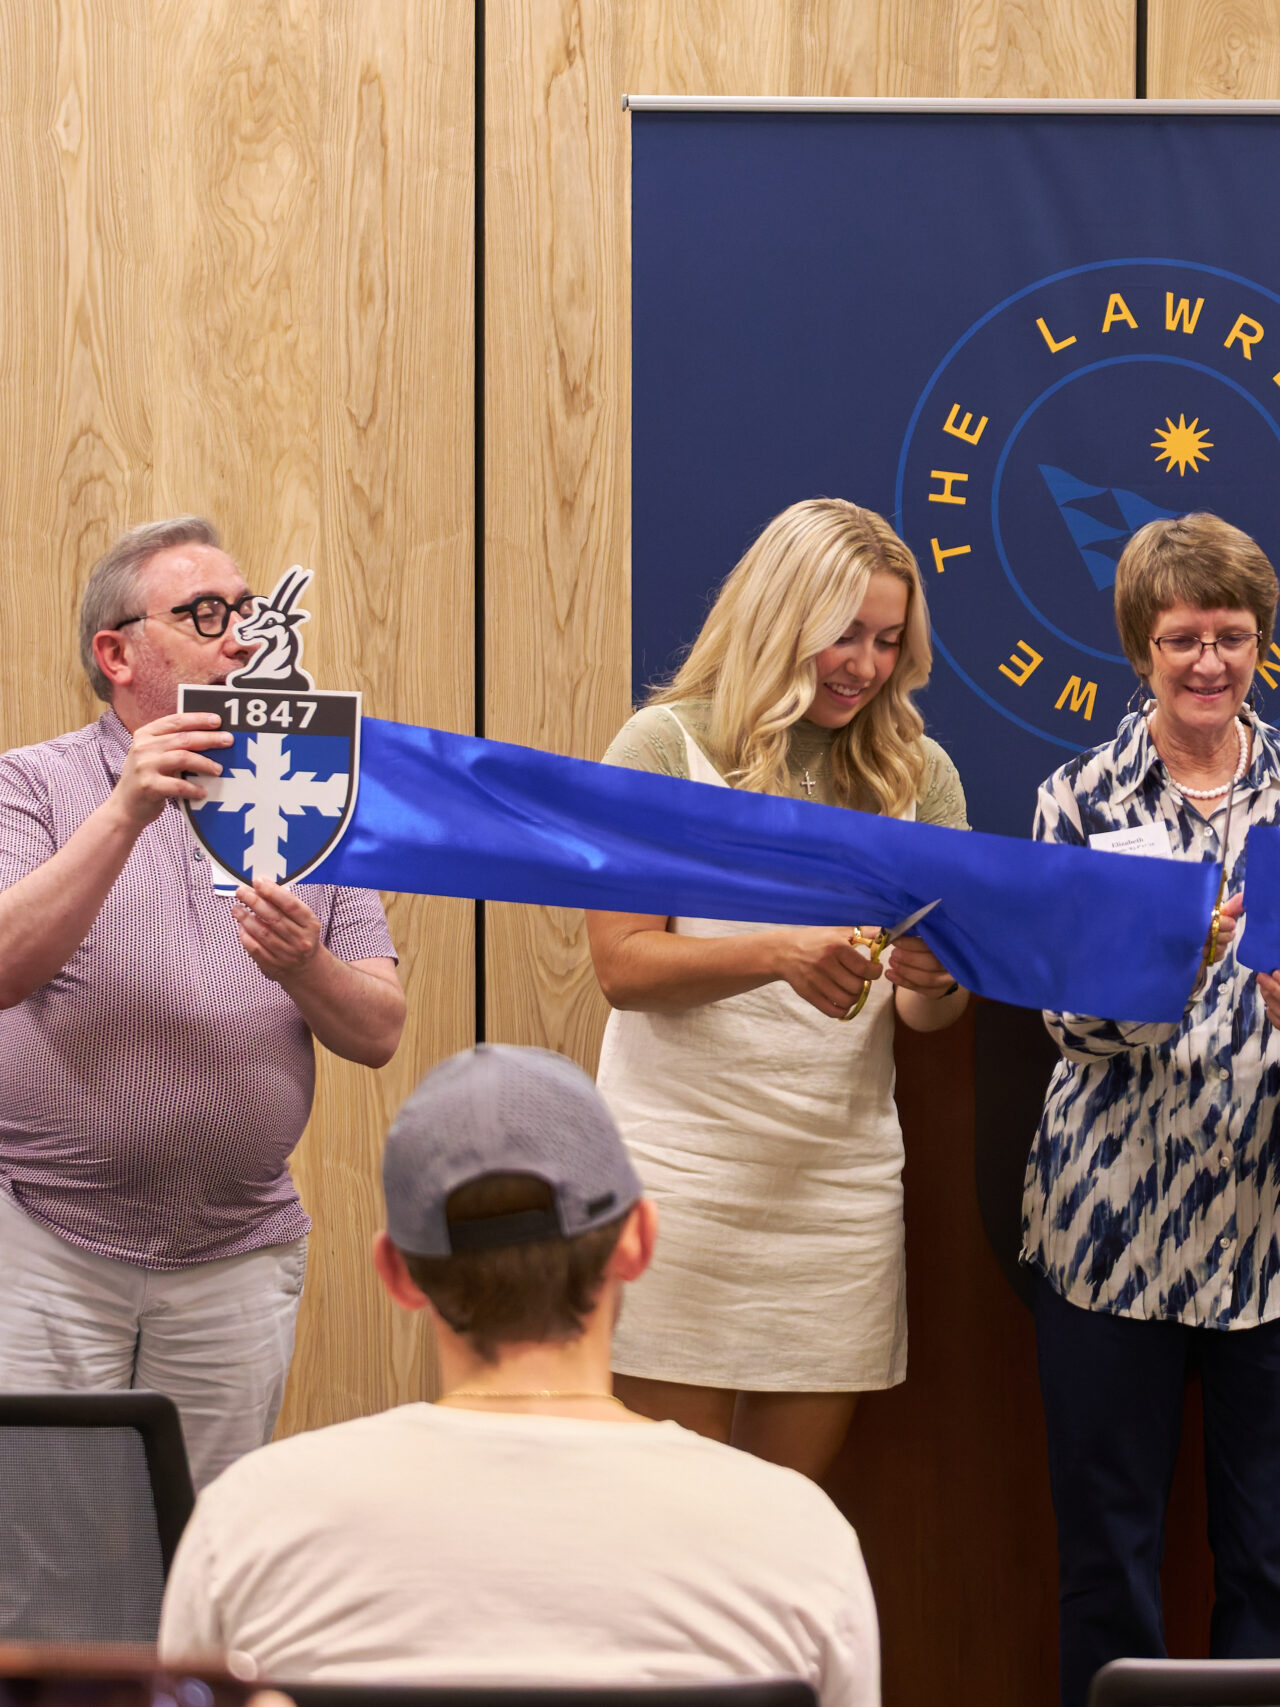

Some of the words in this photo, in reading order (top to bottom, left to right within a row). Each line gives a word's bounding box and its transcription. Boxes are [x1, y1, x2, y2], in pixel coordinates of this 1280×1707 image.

[929, 403, 989, 573] THE
[224, 698, 318, 728] 1847
[998, 640, 1098, 720] WE
